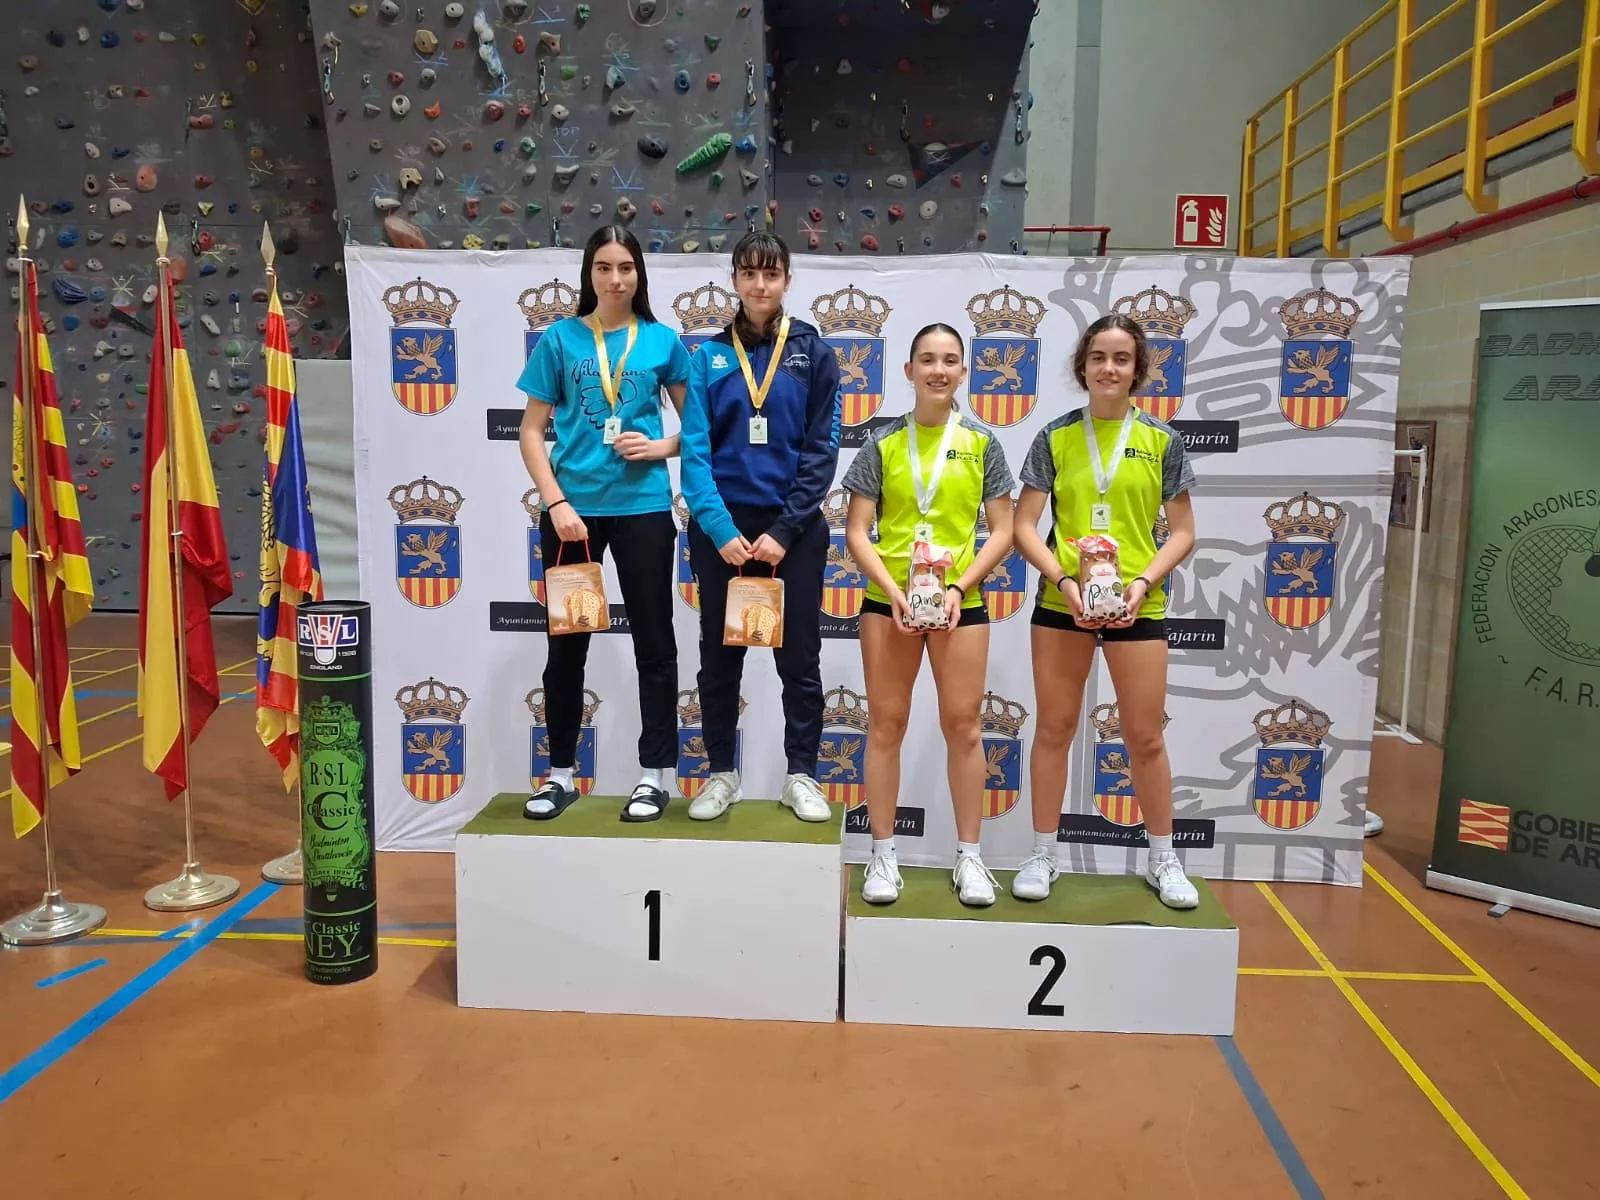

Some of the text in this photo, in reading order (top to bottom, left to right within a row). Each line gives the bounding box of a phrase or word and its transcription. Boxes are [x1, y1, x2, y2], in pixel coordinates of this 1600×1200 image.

[1503, 489, 1600, 540] ARAGONES
[1471, 543, 1502, 644] FEDERACION
[306, 803, 356, 817] Classic
[1060, 828, 1120, 838] Ayuntamiento
[1511, 832, 1550, 859] DE
[312, 921, 360, 935] Classic
[644, 890, 661, 961] 1
[1028, 945, 1067, 1016] 2
